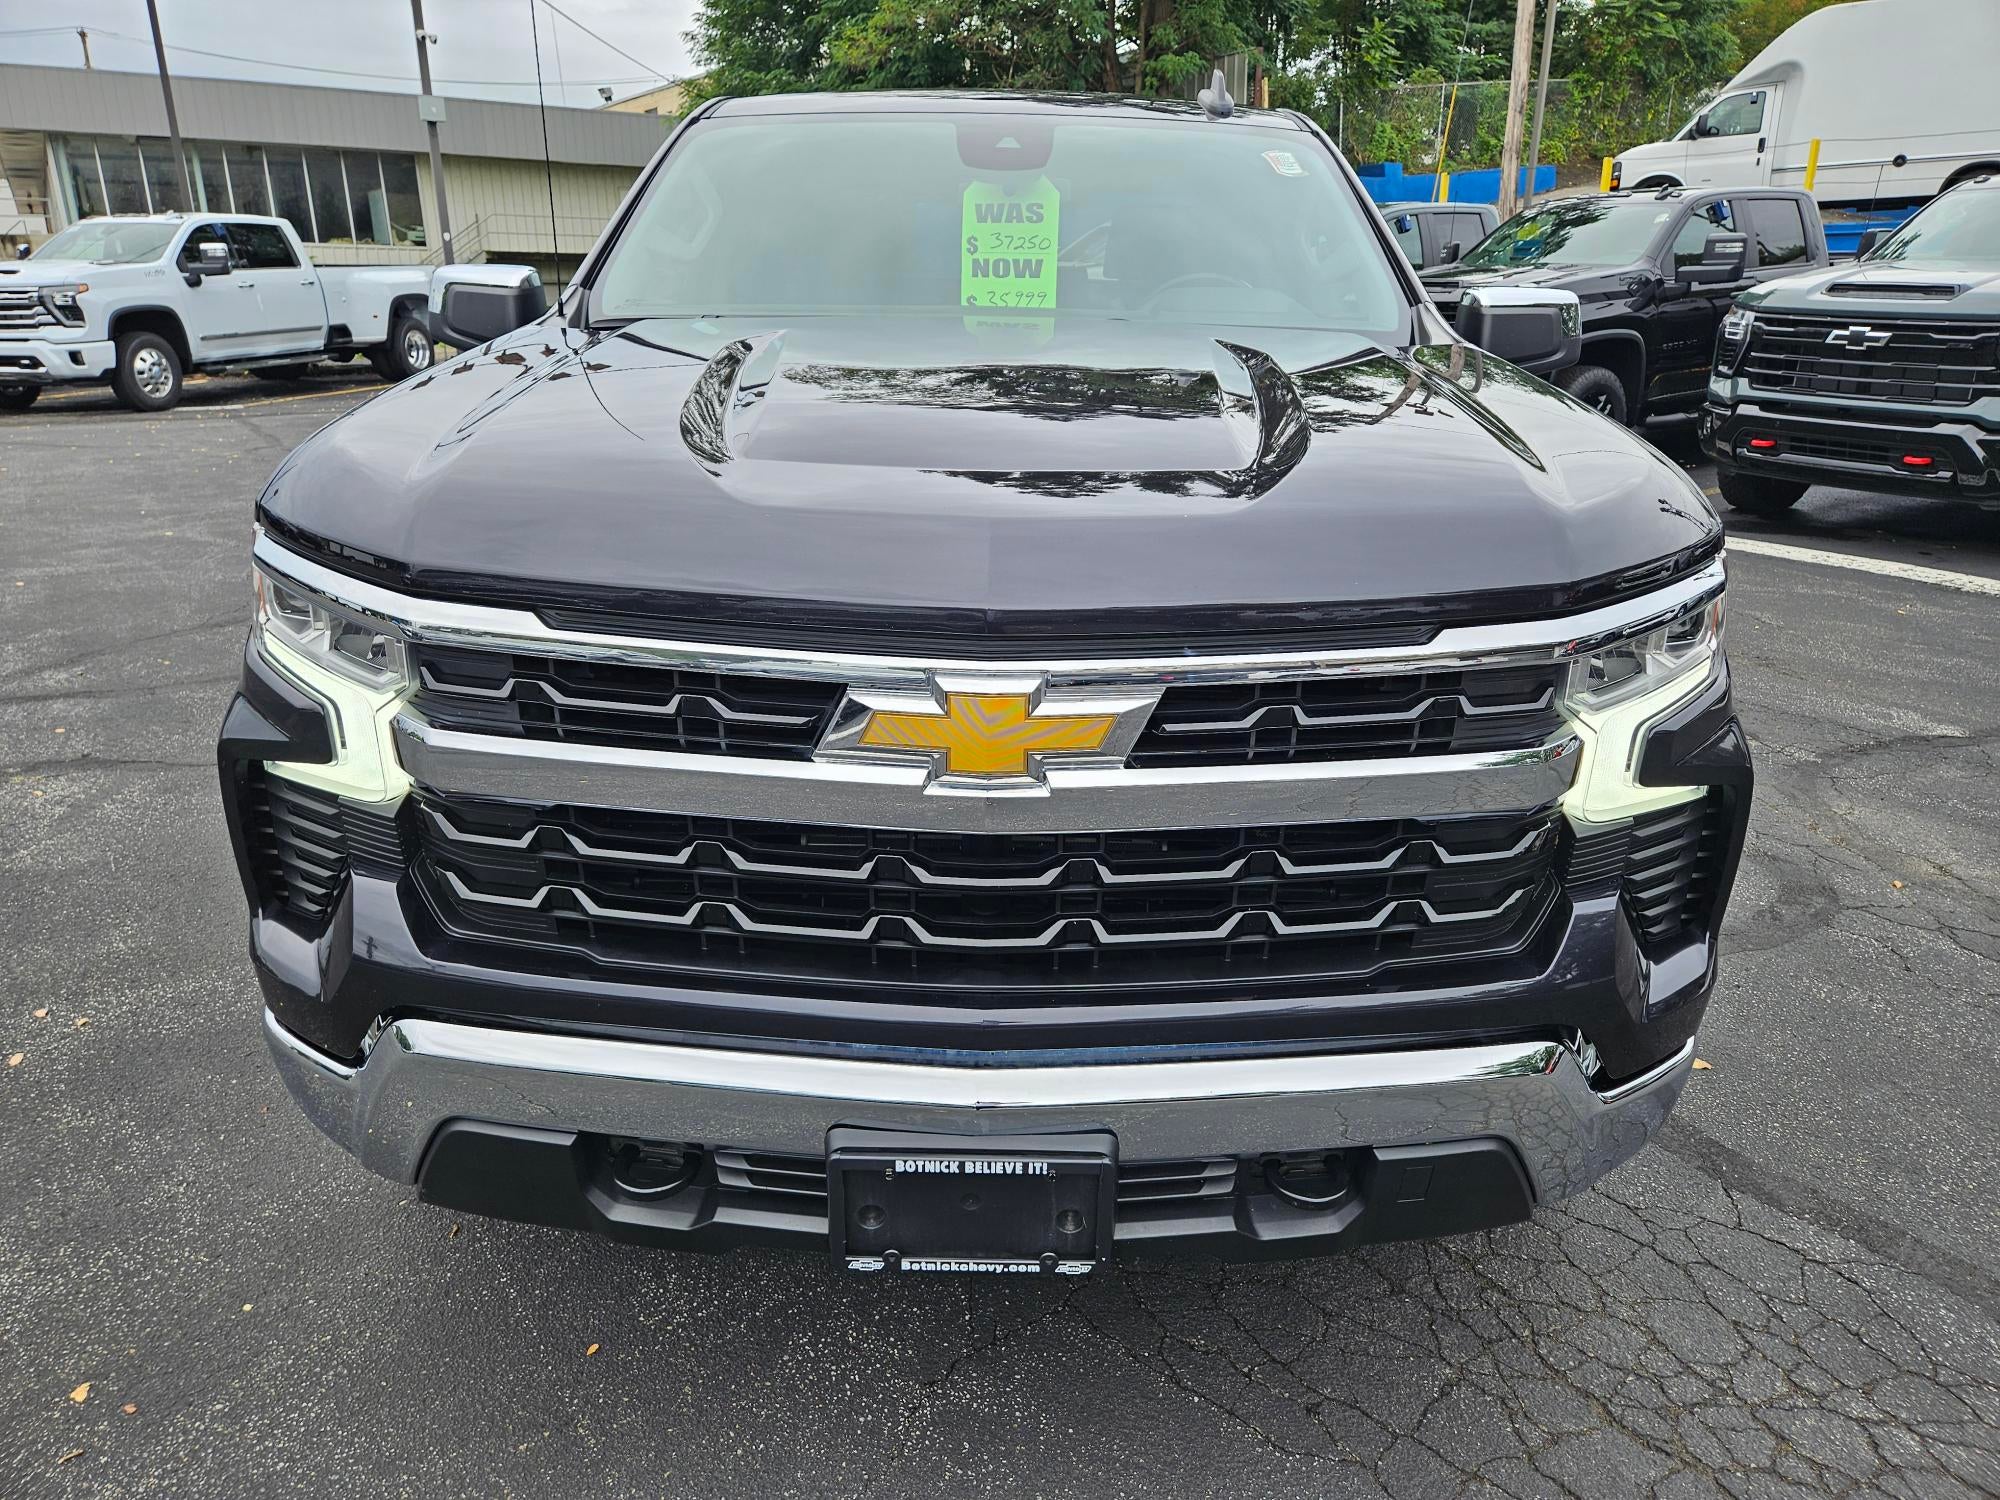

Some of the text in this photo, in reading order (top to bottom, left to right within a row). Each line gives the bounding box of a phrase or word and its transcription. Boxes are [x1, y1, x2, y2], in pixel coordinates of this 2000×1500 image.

[975, 202, 1044, 224] WAS
[966, 232, 1051, 255] $ 37250
[971, 258, 1044, 278] NOW
[895, 1160, 1048, 1175] BOTNICK BELIEVE IT!
[901, 1261, 1040, 1273] Botnickchevy.com
